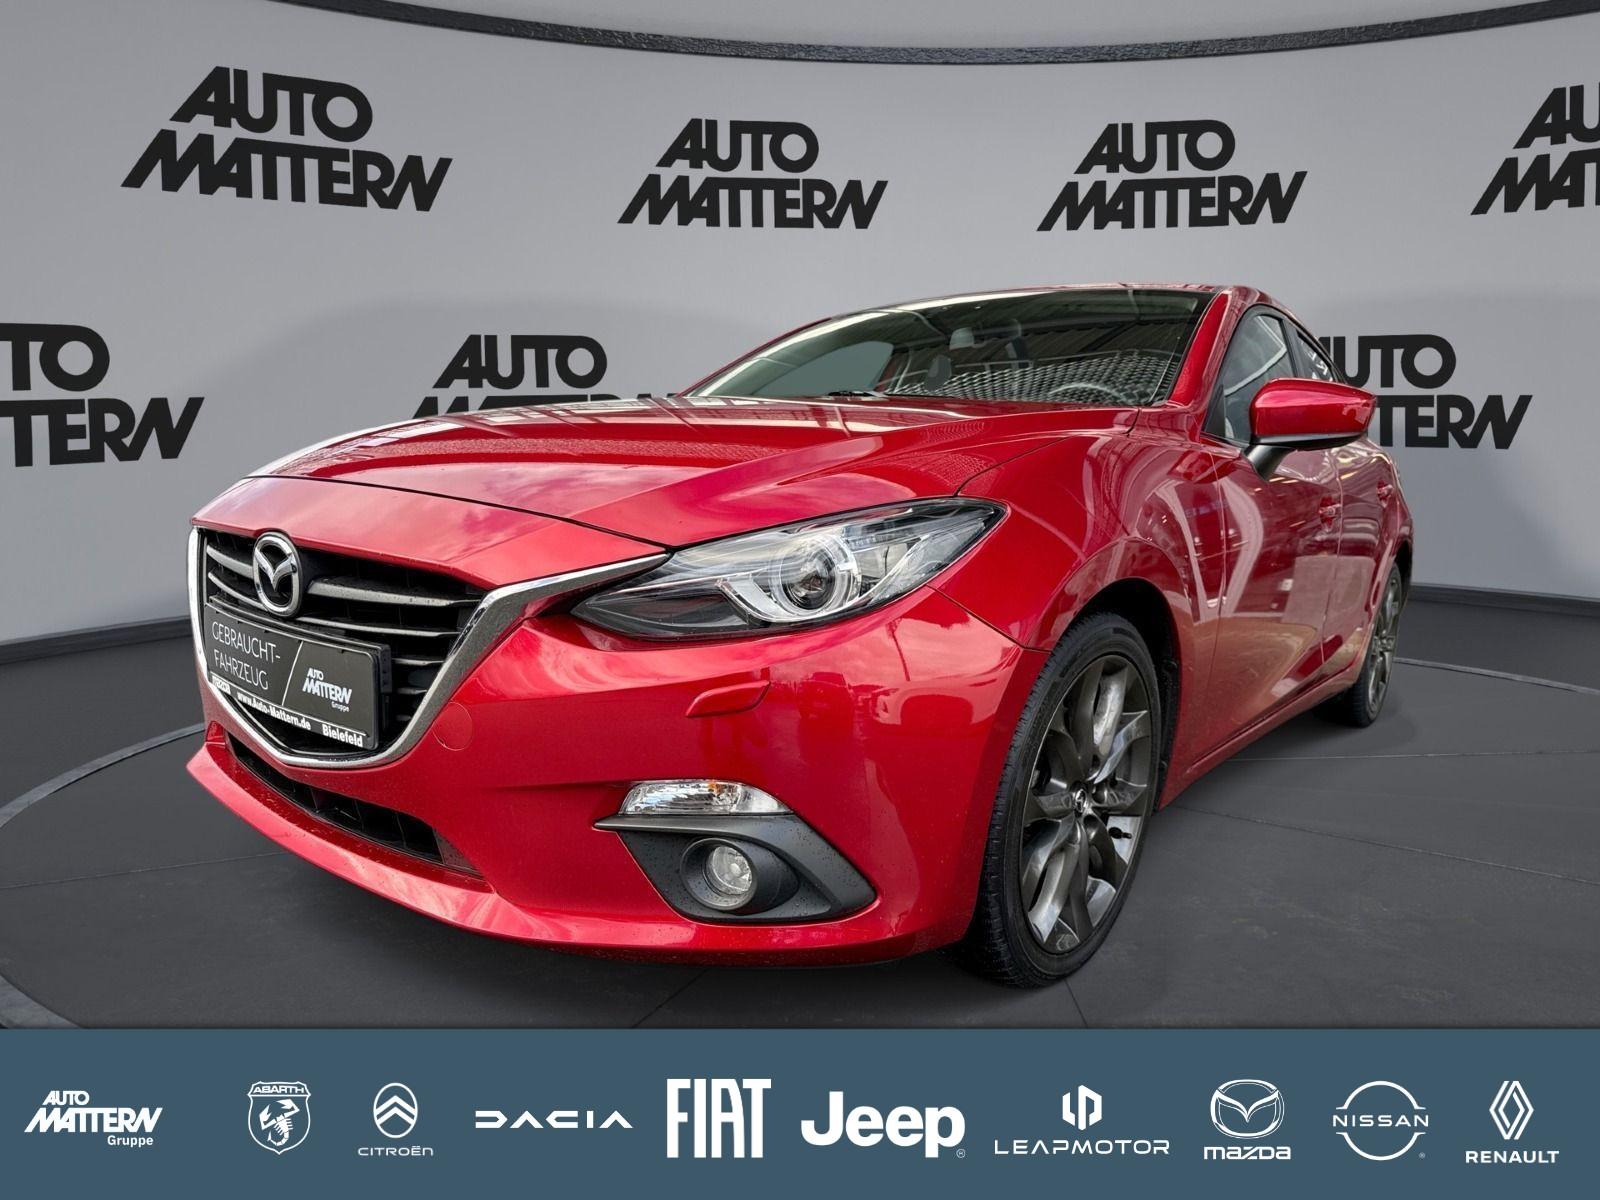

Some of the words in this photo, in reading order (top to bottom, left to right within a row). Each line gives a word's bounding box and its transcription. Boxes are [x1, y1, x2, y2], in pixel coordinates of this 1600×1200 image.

[170, 66, 373, 142] AUTO
[1512, 82, 1600, 149] AU
[121, 129, 452, 211] MATTERN
[656, 118, 819, 173] AUTO
[1074, 119, 1235, 174] AUTO
[617, 174, 888, 229] MATTERN
[1036, 171, 1307, 231] MATTERN
[0, 323, 110, 392] TO
[432, 334, 607, 389] AUTO
[0, 397, 205, 467] TERN
[1375, 395, 1533, 449] TERN
[212, 621, 281, 663] GEBRAUCHT-
[214, 648, 269, 691] FAHRZEUG
[302, 678, 352, 704] MATTERN
[306, 667, 324, 681] AUTO
[236, 691, 312, 730] www.Auto-Mattern.de
[321, 723, 364, 748] Bielefeld
